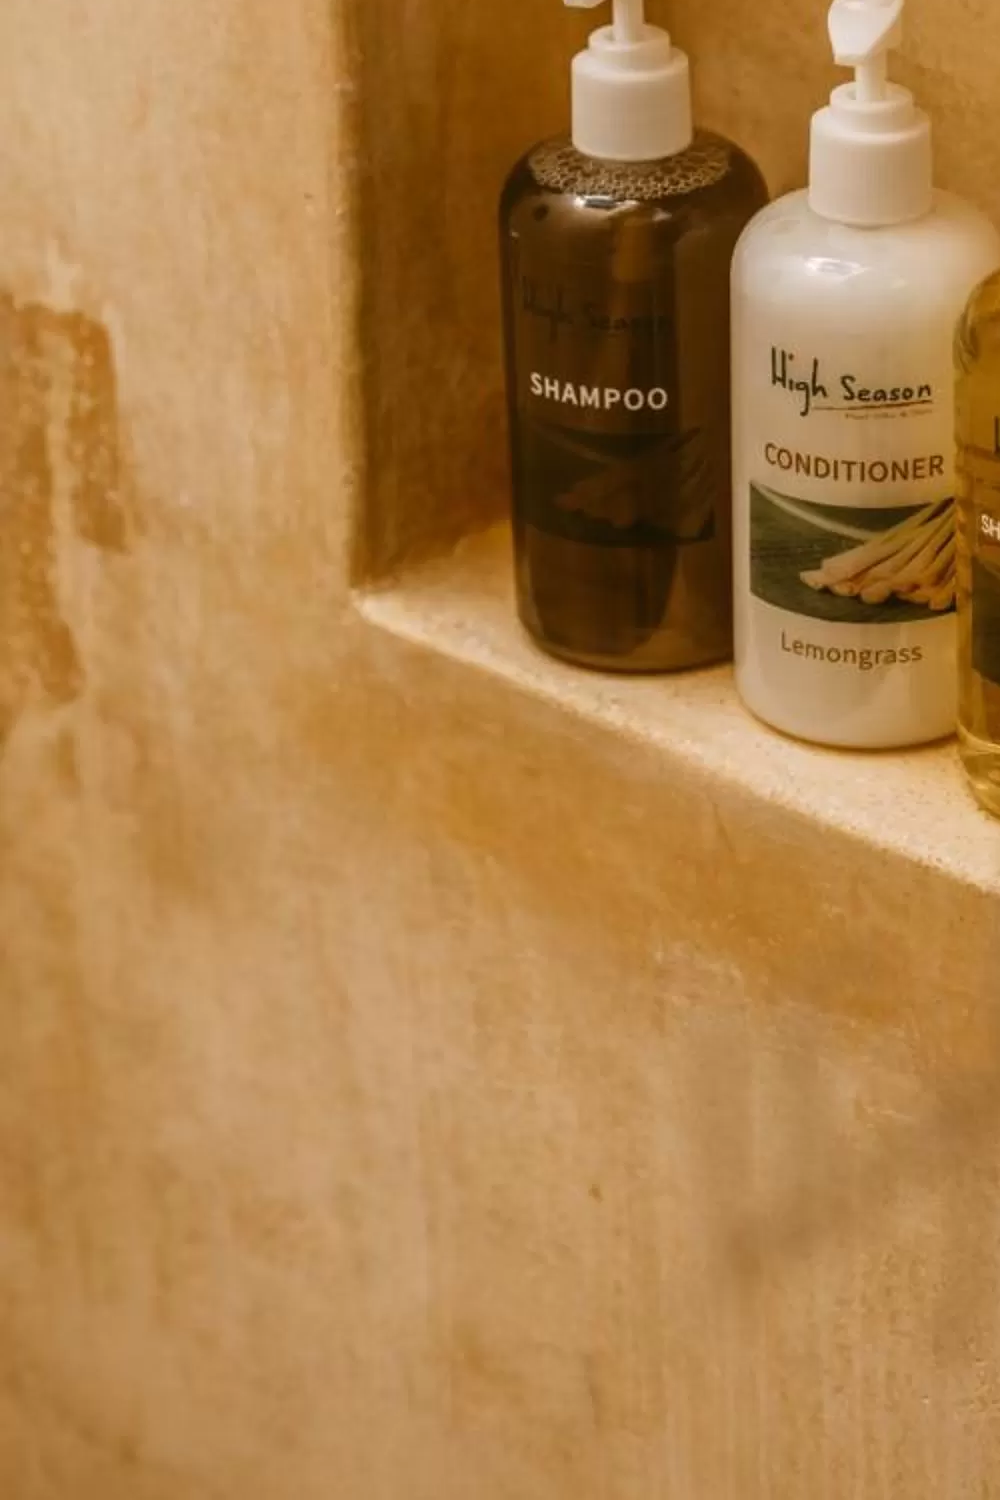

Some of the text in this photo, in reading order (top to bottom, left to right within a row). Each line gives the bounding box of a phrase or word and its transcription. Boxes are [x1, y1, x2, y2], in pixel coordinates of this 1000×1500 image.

[530, 372, 668, 411] SHAMPOO
[771, 346, 932, 417] High Season
[764, 443, 945, 483] CONDITIONER
[781, 630, 923, 671] Lemongrass
